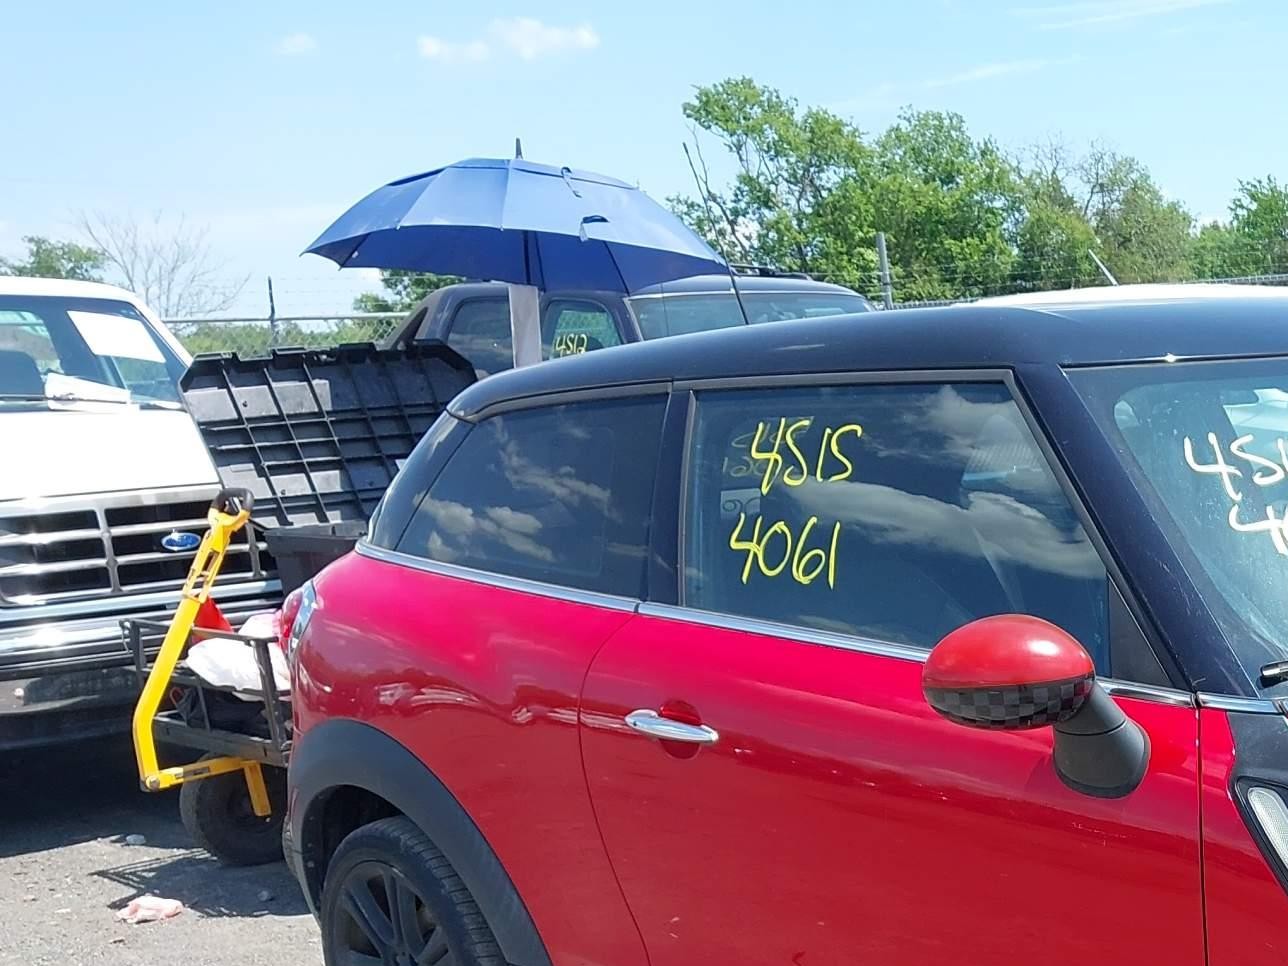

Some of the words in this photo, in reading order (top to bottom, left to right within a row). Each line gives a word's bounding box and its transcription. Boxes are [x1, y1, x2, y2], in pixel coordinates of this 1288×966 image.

[555, 333, 588, 358] 4512
[751, 417, 863, 496] 4515
[729, 512, 841, 590] 4061
